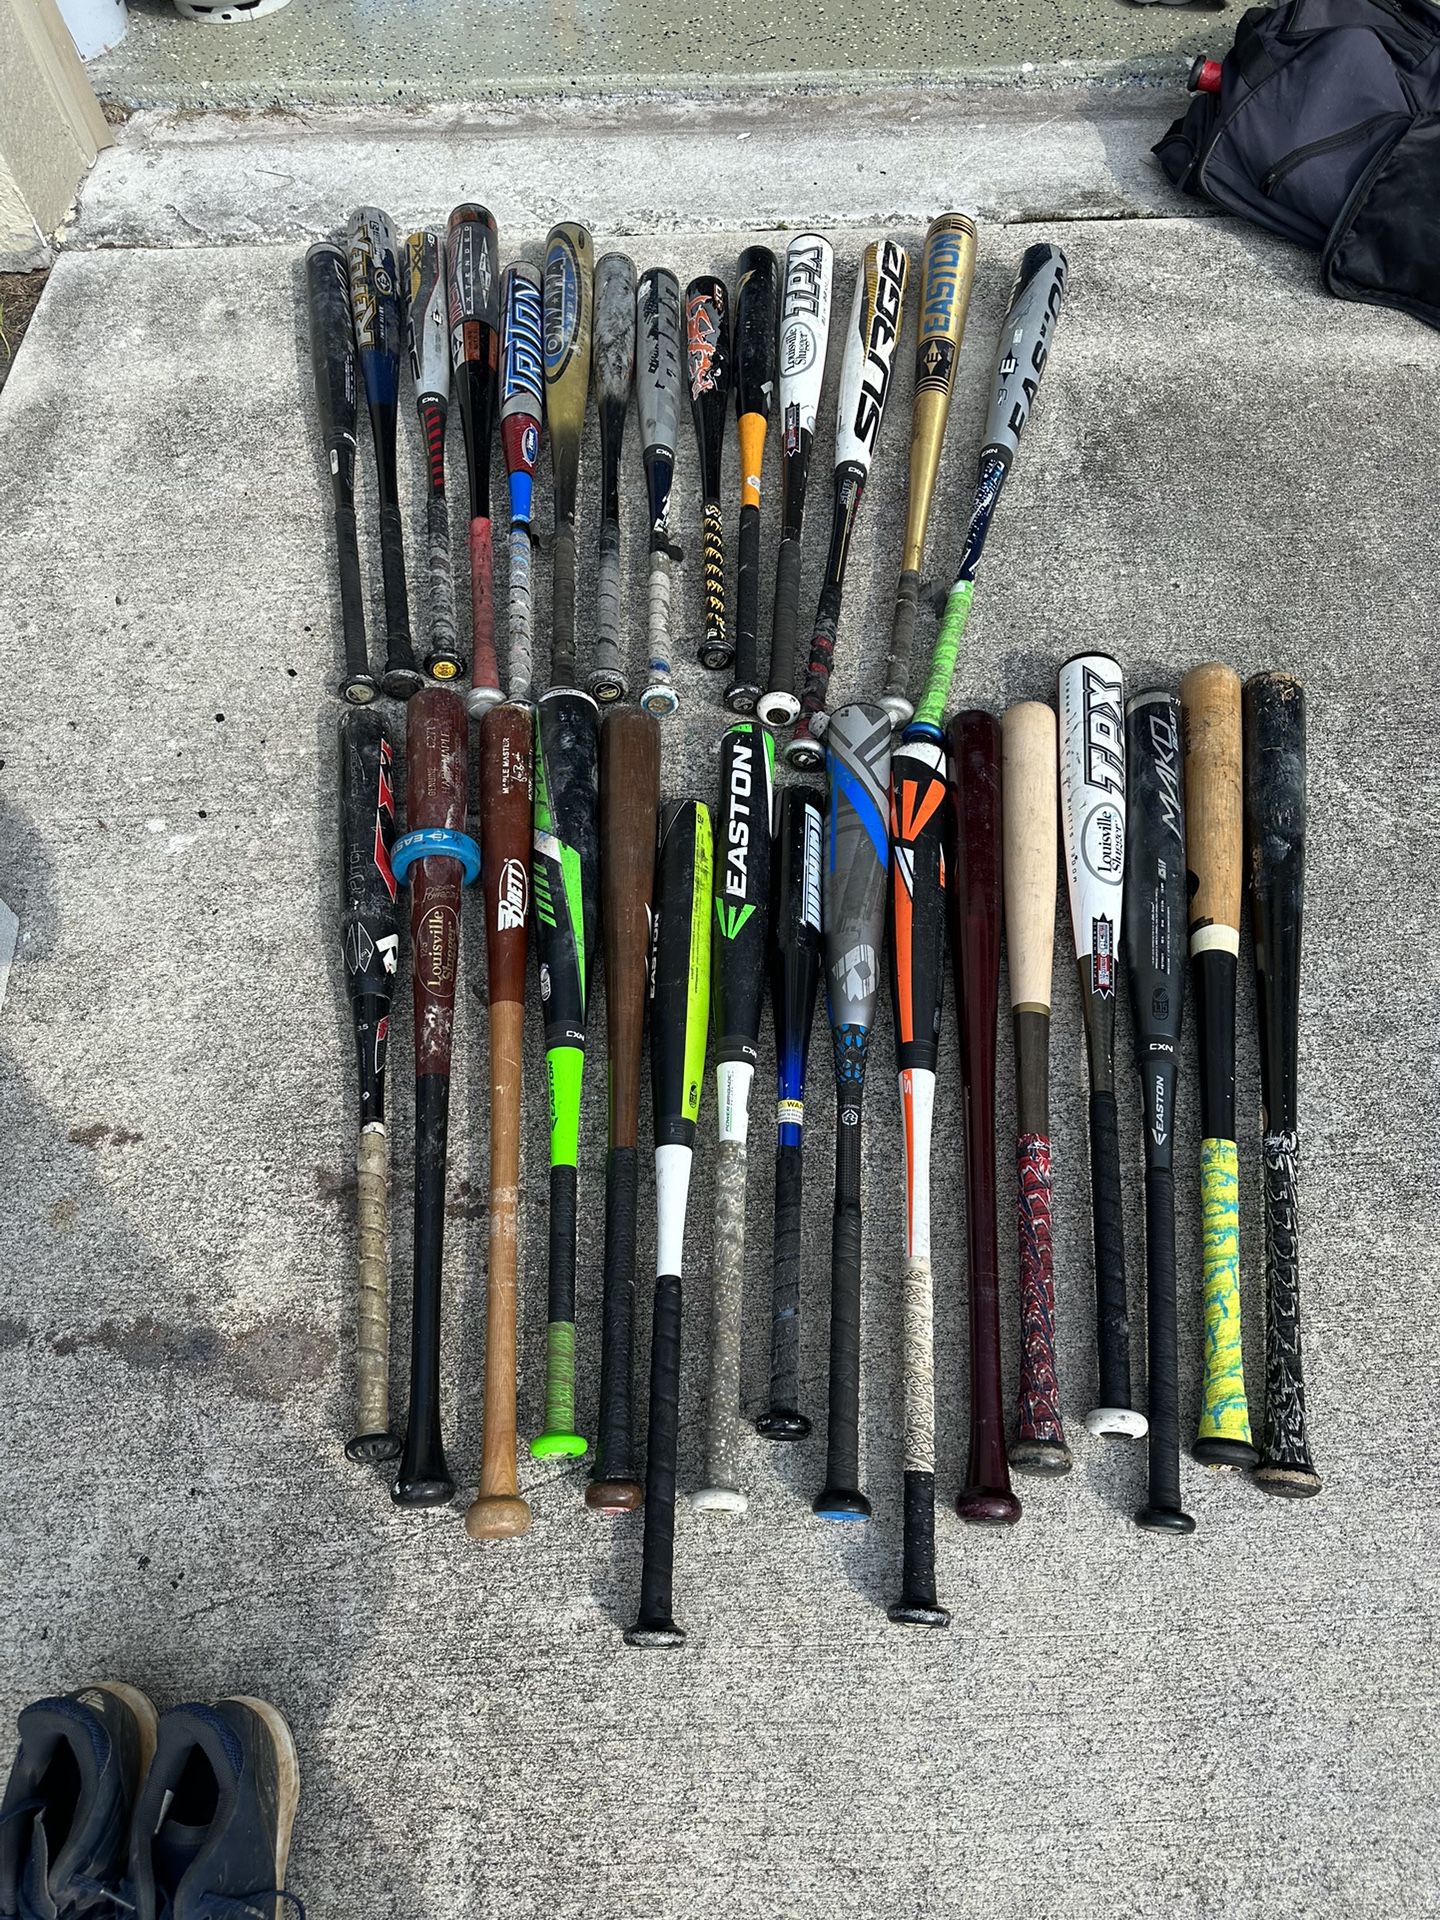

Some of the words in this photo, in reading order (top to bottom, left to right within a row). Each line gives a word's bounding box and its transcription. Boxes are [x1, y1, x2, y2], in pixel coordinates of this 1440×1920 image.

[411, 232, 424, 272] XXL
[349, 224, 376, 346] REFLEX
[544, 257, 566, 357] OMAHA
[783, 246, 823, 322] TPX
[923, 233, 962, 334] EASTON
[504, 270, 543, 405] TRITON
[784, 328, 797, 373] Louisville
[795, 330, 809, 366] Slugger
[854, 240, 906, 458] SURGE
[421, 396, 439, 404] CXN
[848, 466, 865, 478] CXN
[981, 448, 998, 458] CXN
[502, 737, 510, 768] MASTER
[1082, 665, 1125, 795] TPX
[1168, 706, 1180, 752] BEAST
[1149, 714, 1183, 841] MAKO
[725, 744, 753, 899] EASTON
[1097, 810, 1112, 873] Louisville
[1112, 825, 1123, 875] Slugger
[498, 863, 526, 931] BRETT
[428, 910, 445, 988] Louisville
[442, 922, 457, 982] Slugger
[650, 913, 660, 999] EASTON
[566, 1030, 585, 1042] CXN
[1149, 1043, 1174, 1052] CXN
[548, 1060, 556, 1116] EASTON
[1156, 1075, 1165, 1132] EASTON
